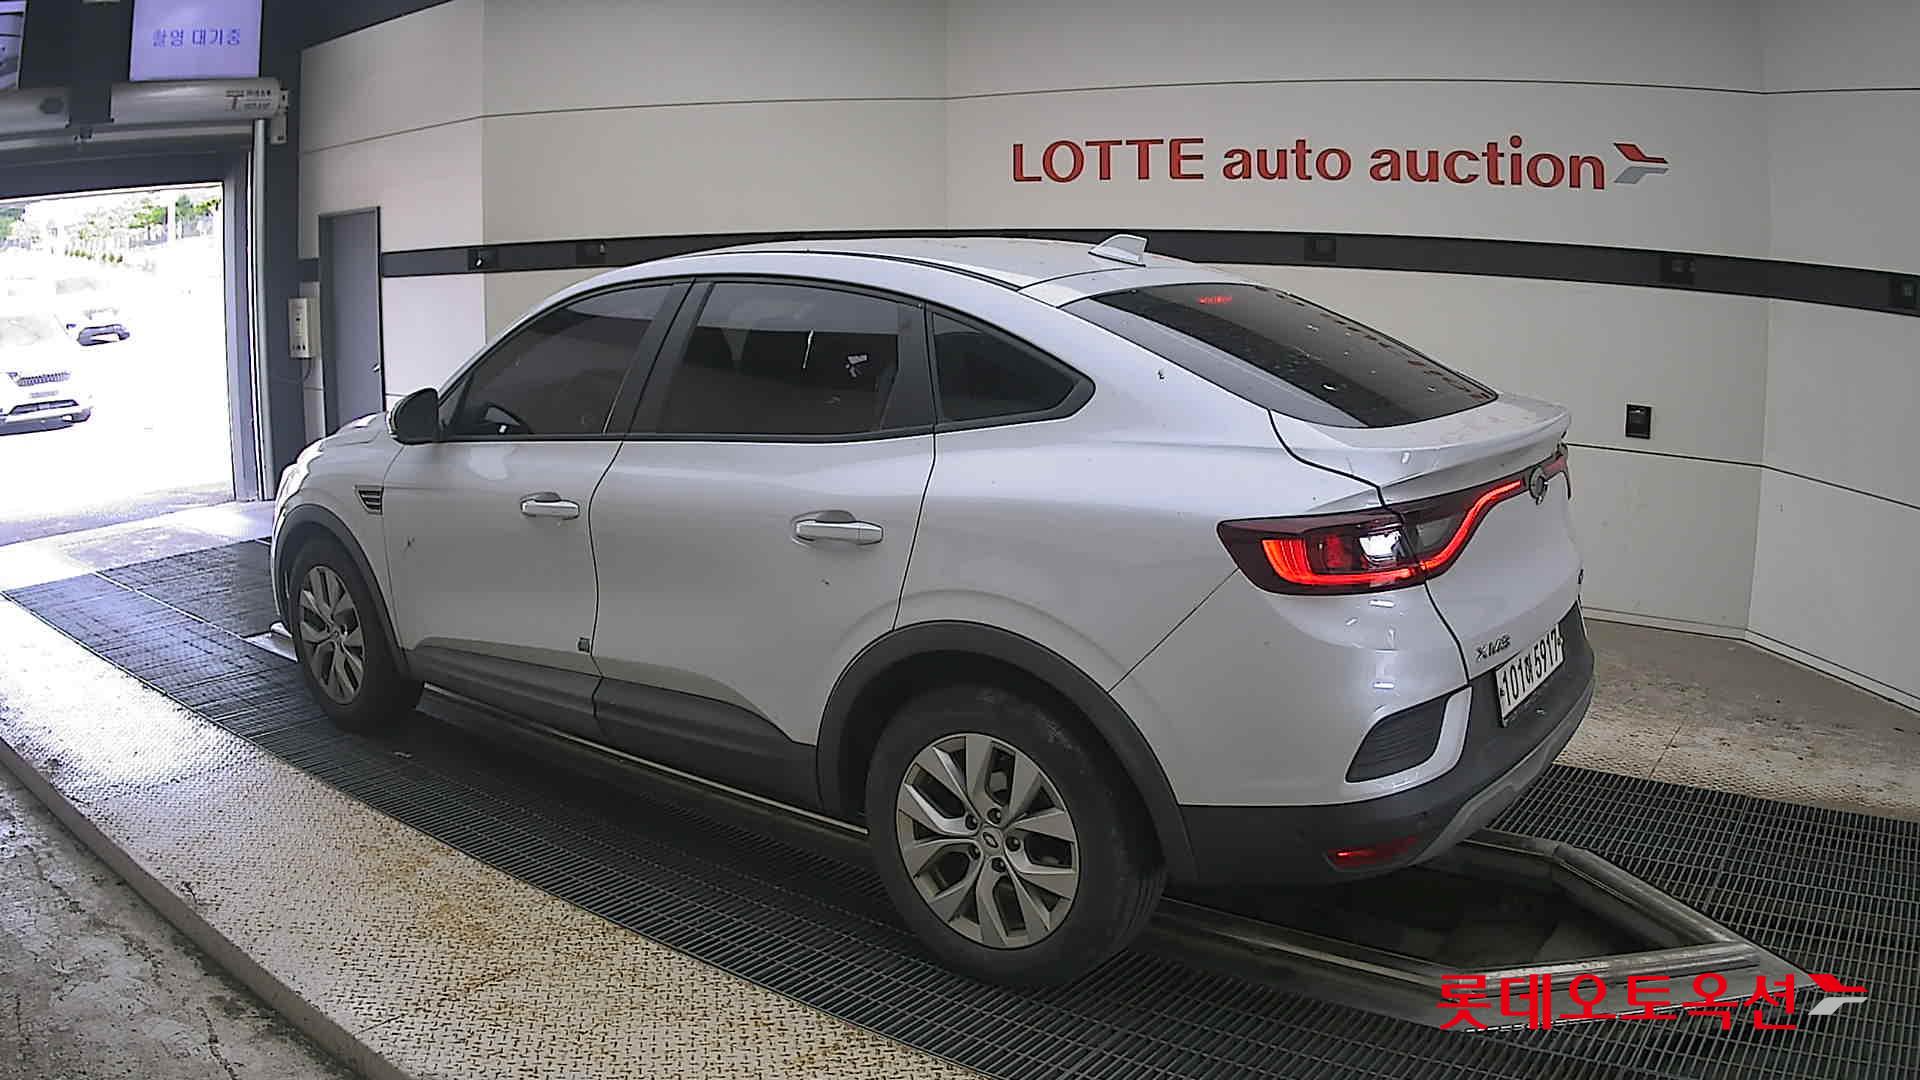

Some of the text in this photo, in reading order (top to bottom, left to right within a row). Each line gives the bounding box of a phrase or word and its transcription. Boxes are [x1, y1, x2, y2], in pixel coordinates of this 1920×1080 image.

[191, 27, 241, 47] 대기중
[1012, 135, 1607, 190] LOTTE auto auction
